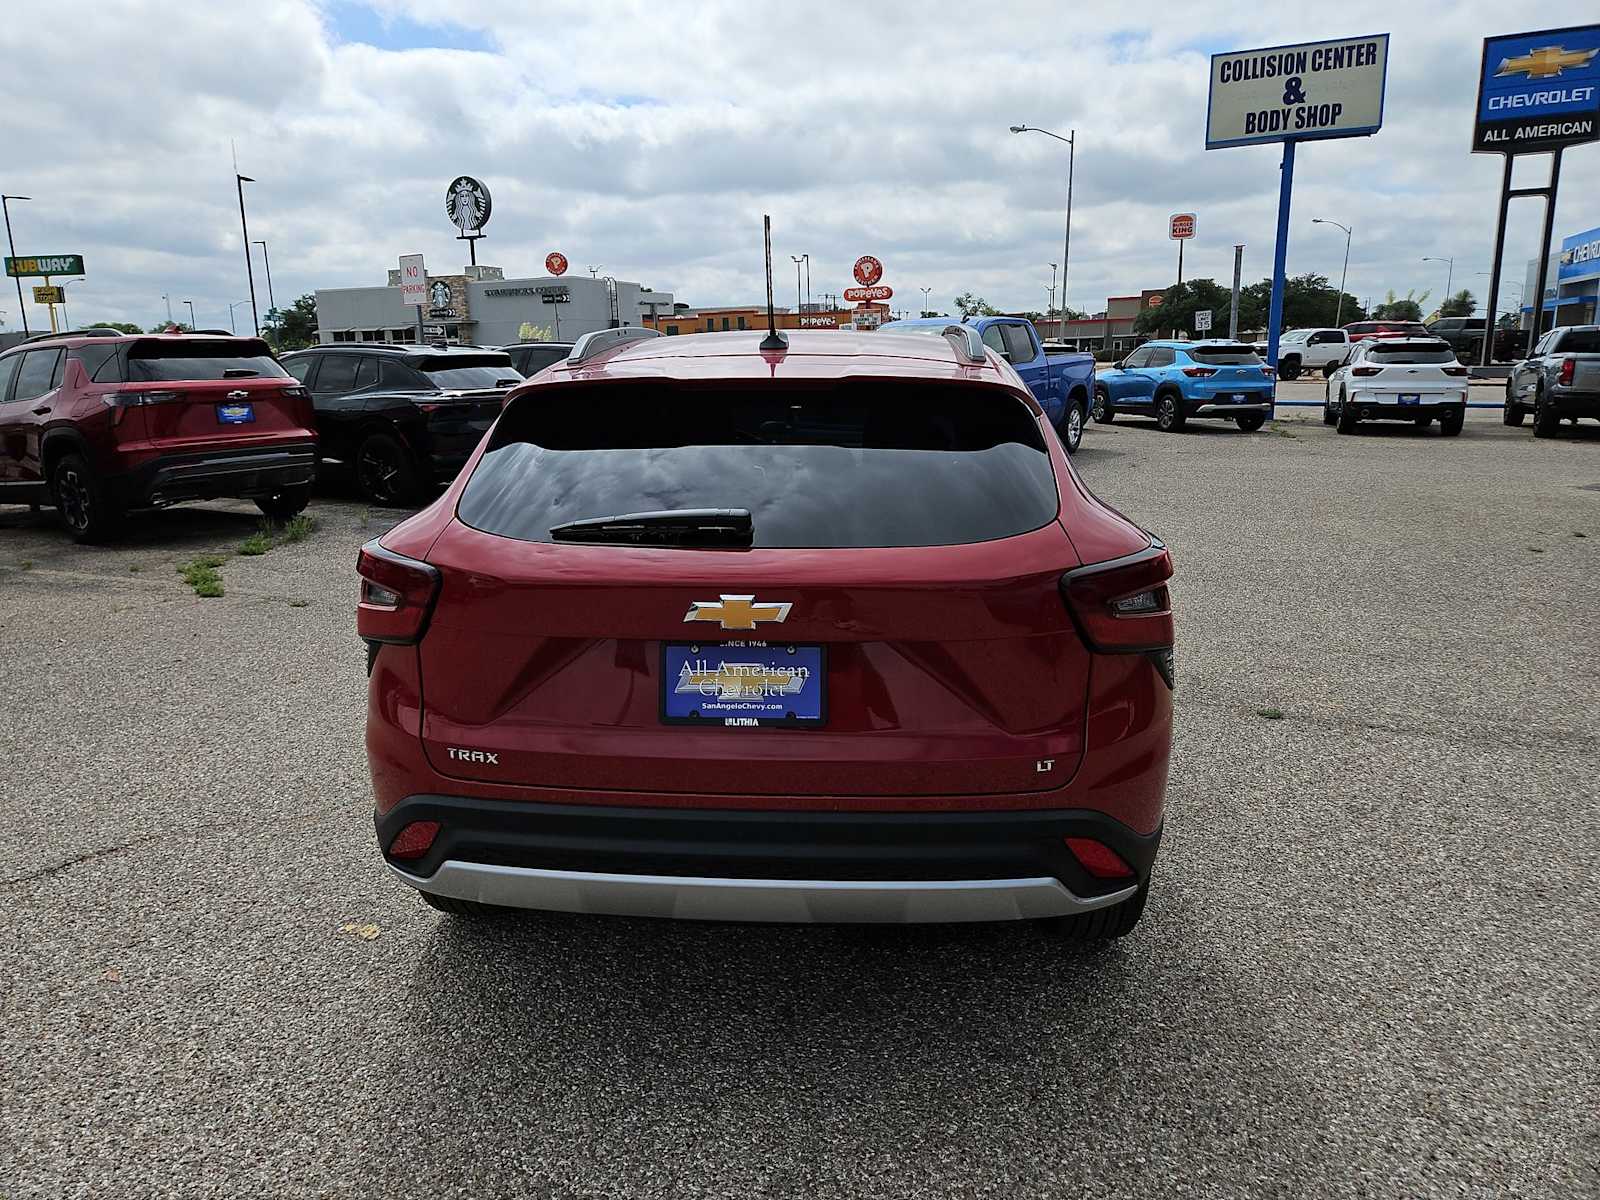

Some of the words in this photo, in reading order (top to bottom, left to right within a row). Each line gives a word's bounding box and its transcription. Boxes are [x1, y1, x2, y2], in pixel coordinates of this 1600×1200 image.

[1220, 51, 1308, 83] COLLISION
[1311, 42, 1377, 72] CENTER
[1282, 76, 1306, 105] &
[1488, 87, 1595, 110] CHEVROLET
[1245, 108, 1292, 135] BODY
[1294, 103, 1342, 129] SHOP
[1483, 128, 1510, 142] ALL
[1514, 120, 1593, 140] AMERICAN
[1172, 226, 1193, 234] KING
[9, 257, 74, 273] SUBWAY
[405, 265, 418, 278] NO
[402, 284, 425, 294] PARKING
[847, 287, 888, 299] POPEYES
[1197, 321, 1210, 329] 35
[678, 659, 708, 677] All
[716, 660, 810, 678] American
[699, 679, 785, 697] Chevrolet
[702, 702, 783, 711] SanAngeloChevy.com
[732, 717, 759, 727] LITHIA
[447, 747, 499, 765] TRAX
[1036, 759, 1055, 772] LT
